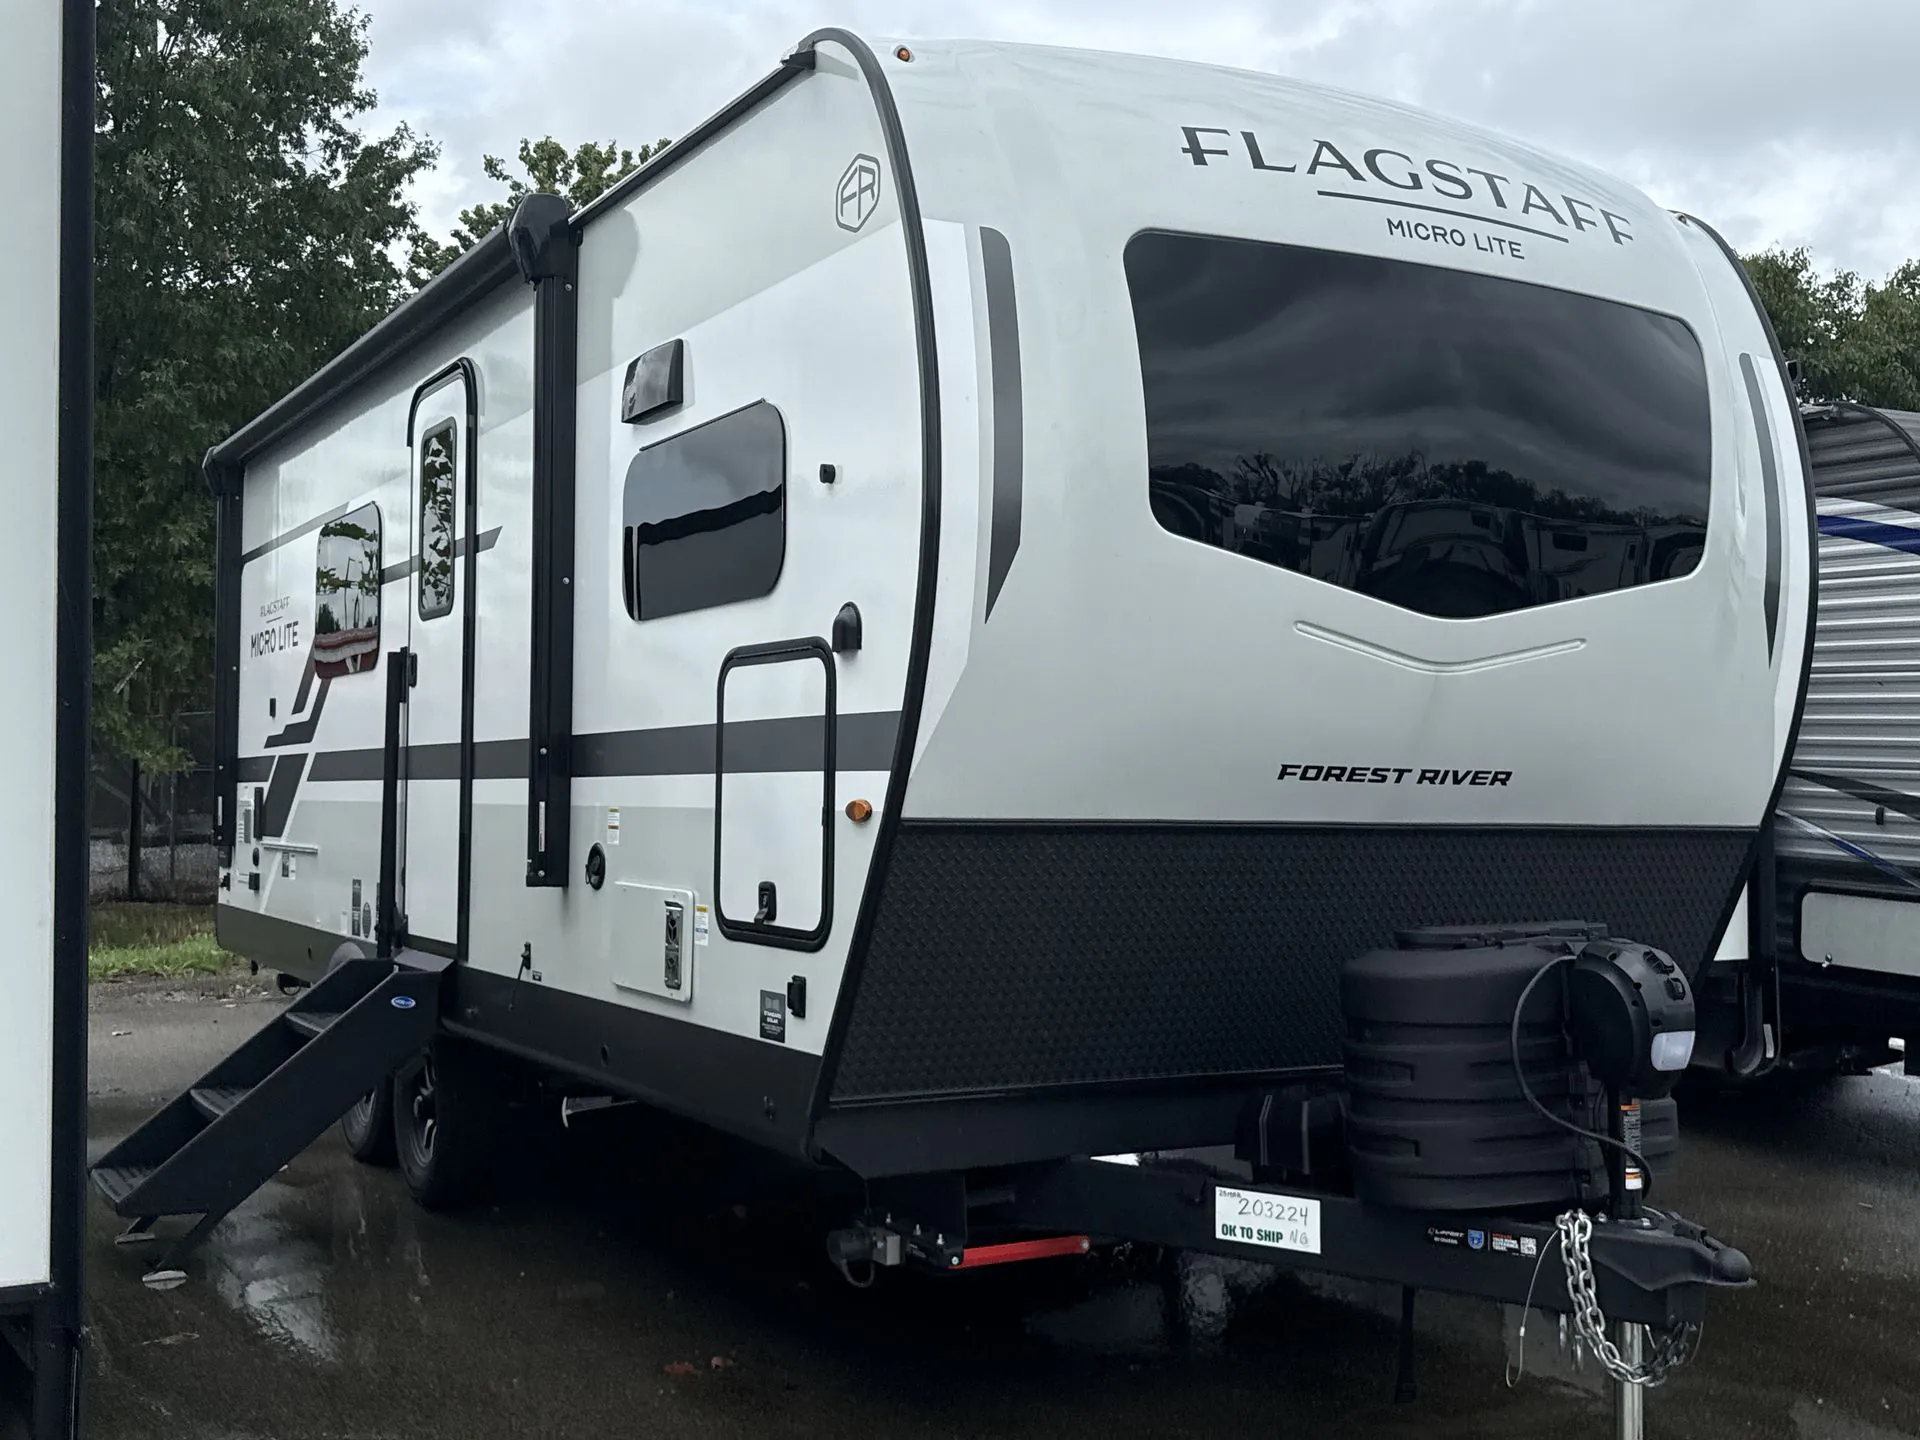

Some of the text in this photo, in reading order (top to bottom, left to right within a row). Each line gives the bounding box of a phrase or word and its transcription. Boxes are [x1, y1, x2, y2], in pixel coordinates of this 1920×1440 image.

[1181, 126, 1634, 245] FLAGSTAFF
[1387, 217, 1525, 260] MICRO LITE
[260, 596, 290, 617] FLAGSTAFF
[250, 620, 299, 658] MICRO LITE
[1277, 763, 1513, 786] FOREST RIVER
[1238, 1198, 1309, 1226] 203224
[1221, 1223, 1284, 1243] OK TO SHIP
